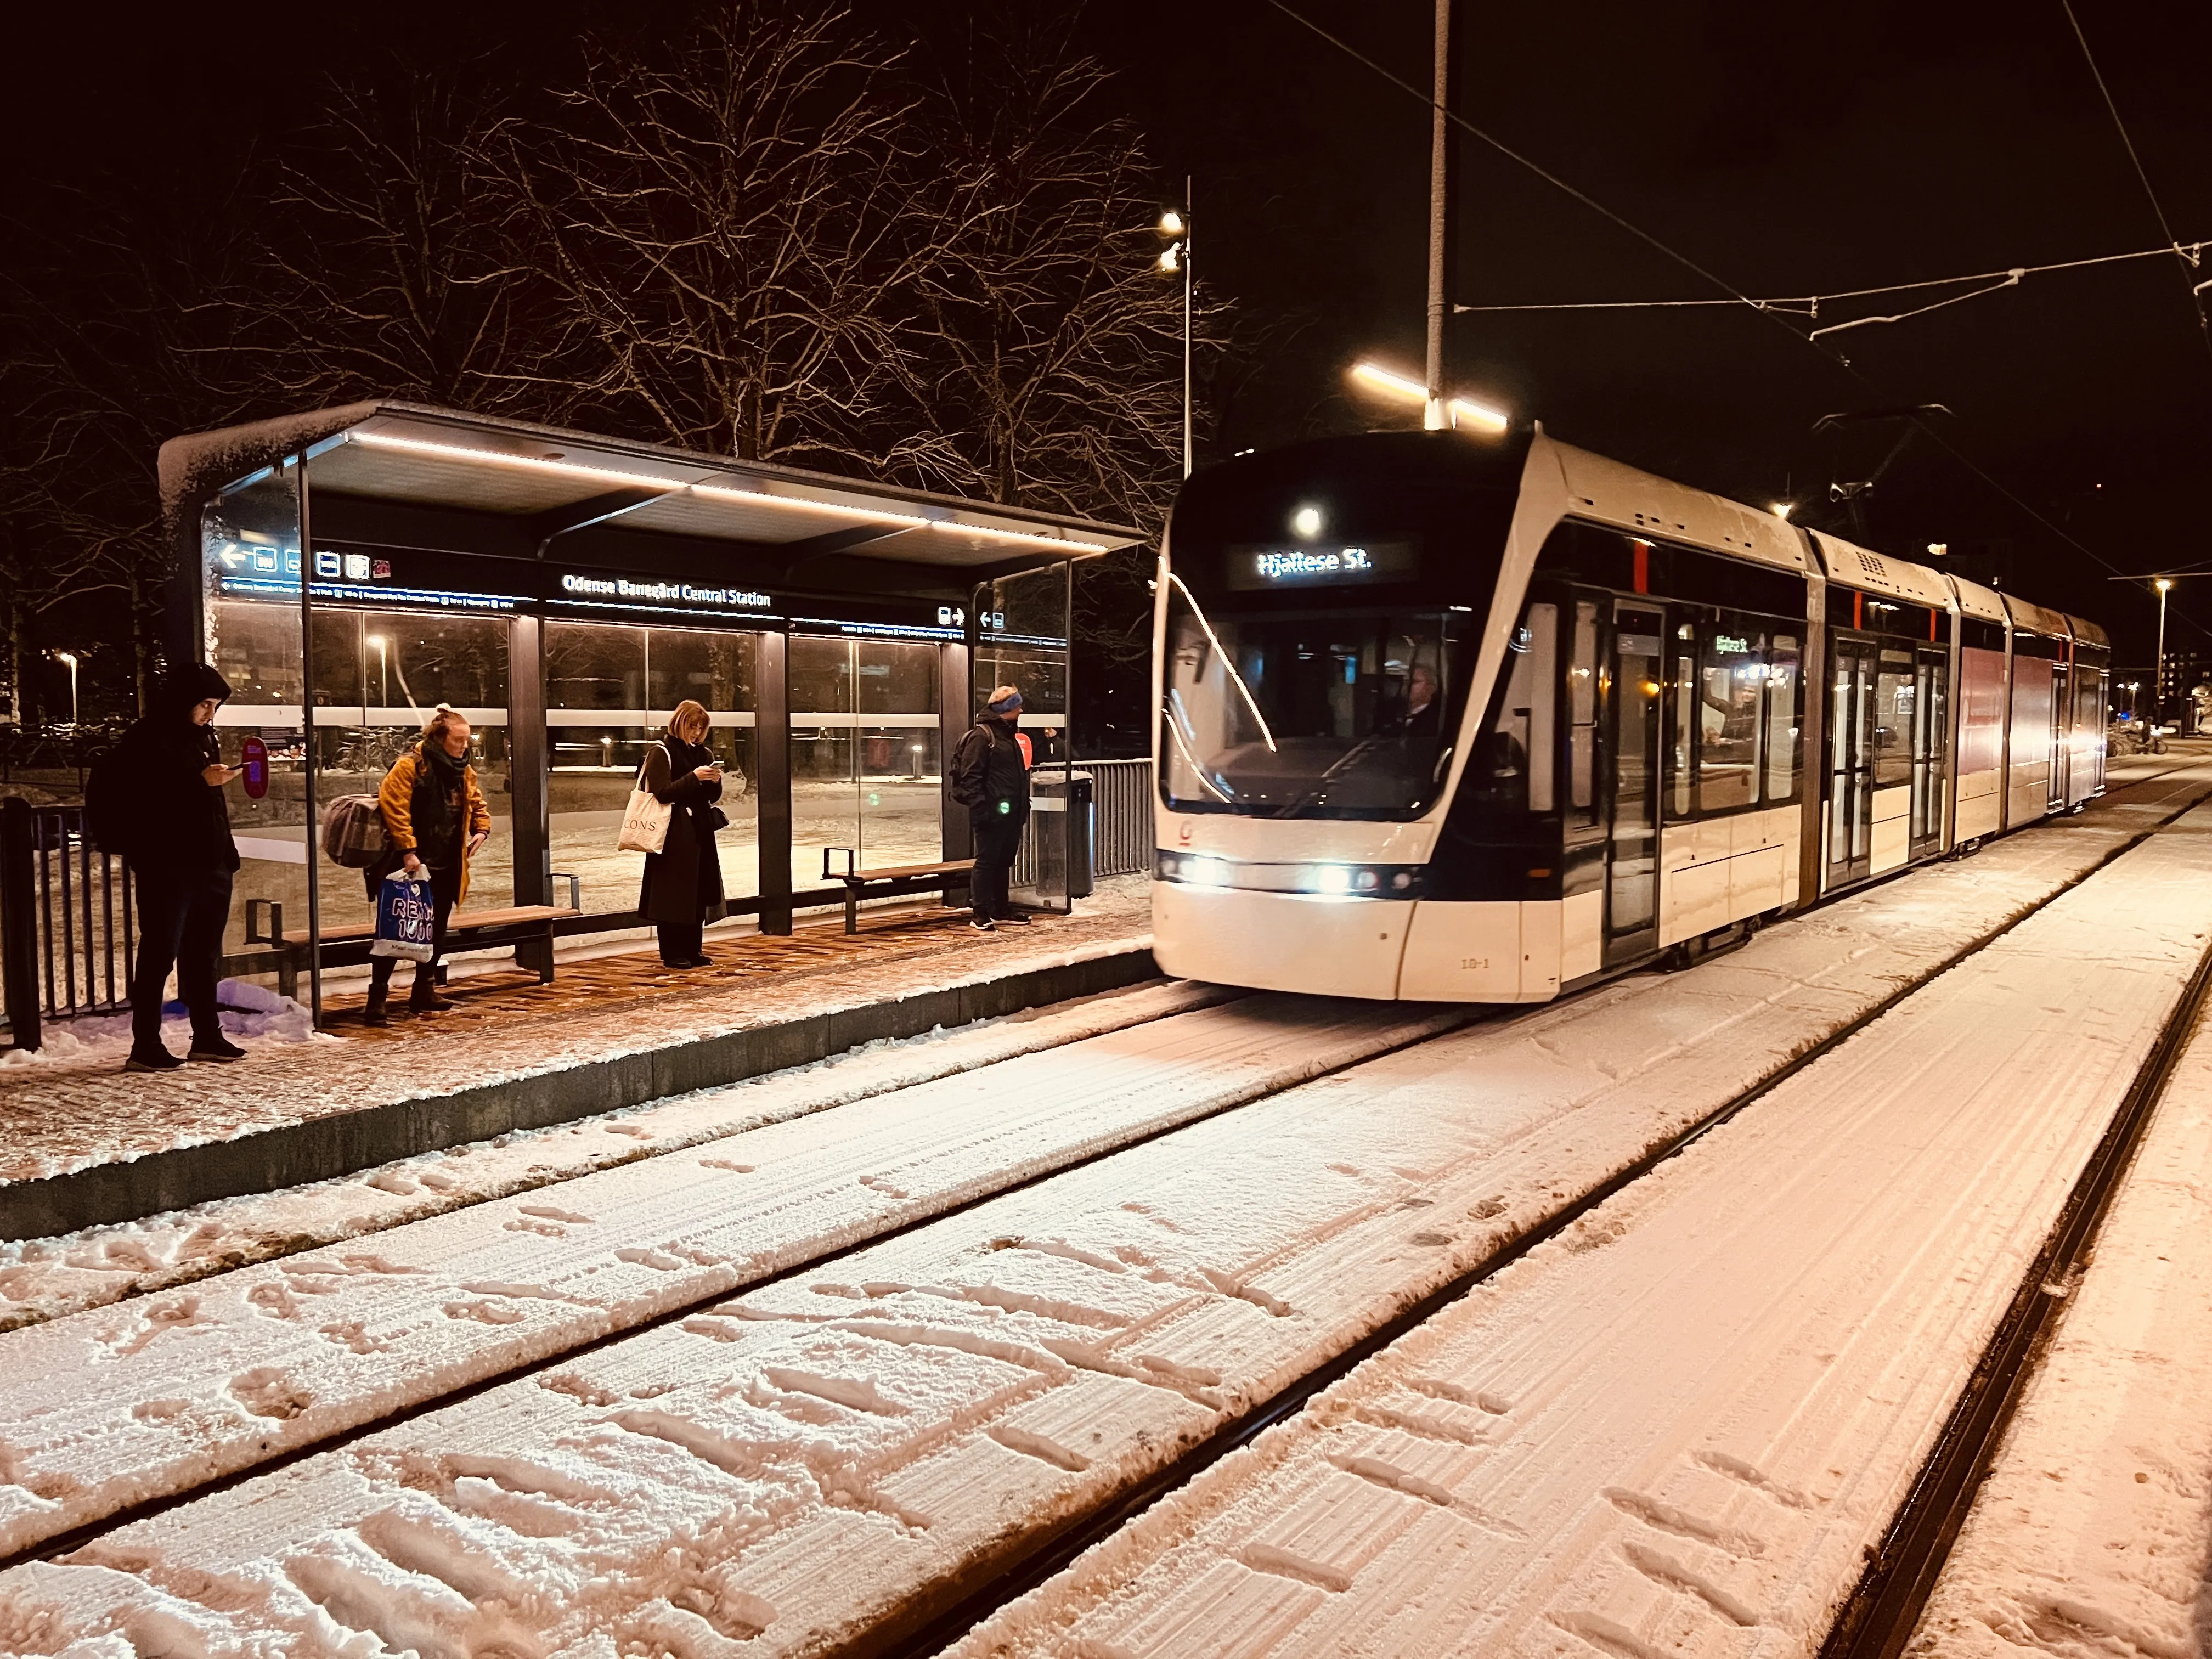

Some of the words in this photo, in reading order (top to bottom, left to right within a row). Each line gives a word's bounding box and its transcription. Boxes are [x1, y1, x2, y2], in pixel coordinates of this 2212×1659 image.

[1343, 547, 1372, 569] St.
[563, 575, 615, 594] Odense
[618, 580, 680, 599] Banegård
[682, 585, 727, 603] Central
[729, 589, 771, 606] Station
[624, 819, 656, 831] CONS
